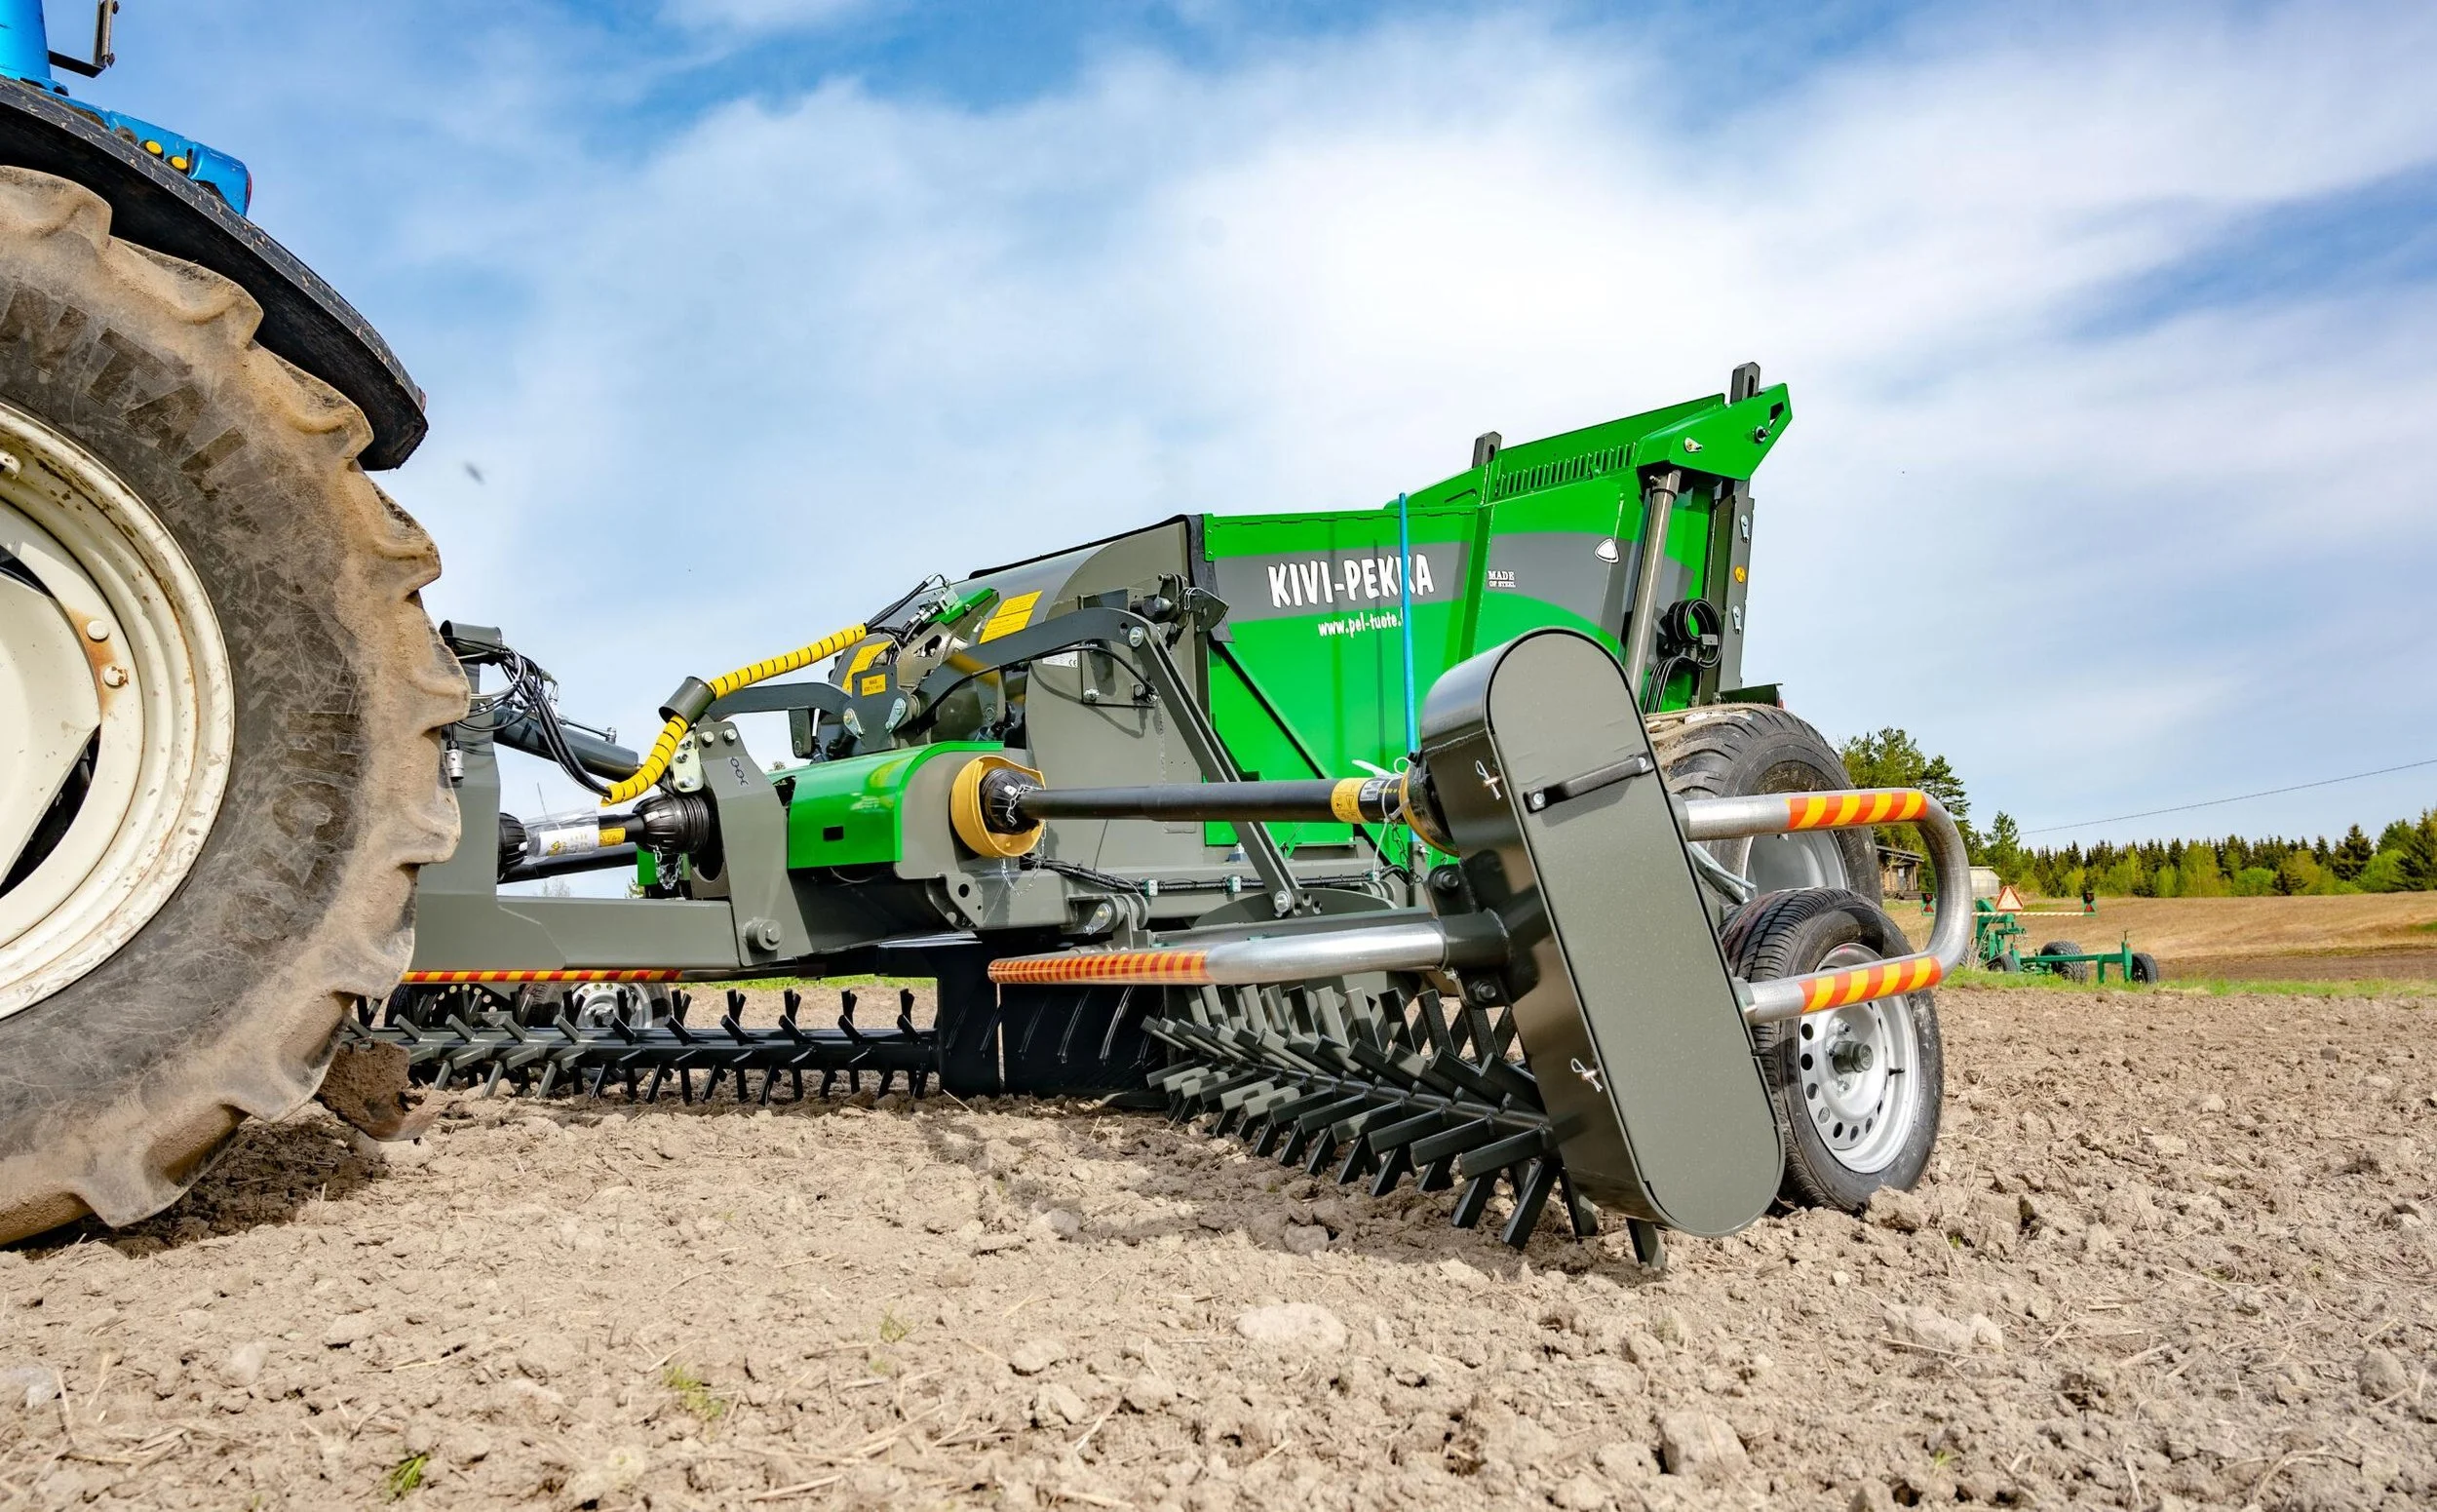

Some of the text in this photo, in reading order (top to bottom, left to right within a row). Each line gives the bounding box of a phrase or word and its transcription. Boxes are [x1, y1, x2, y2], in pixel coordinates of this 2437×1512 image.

[1267, 553, 1435, 608] KIVI-PEKKA
[1488, 570, 1514, 580] MADE
[1318, 607, 1404, 639] www.pel-tuote.
